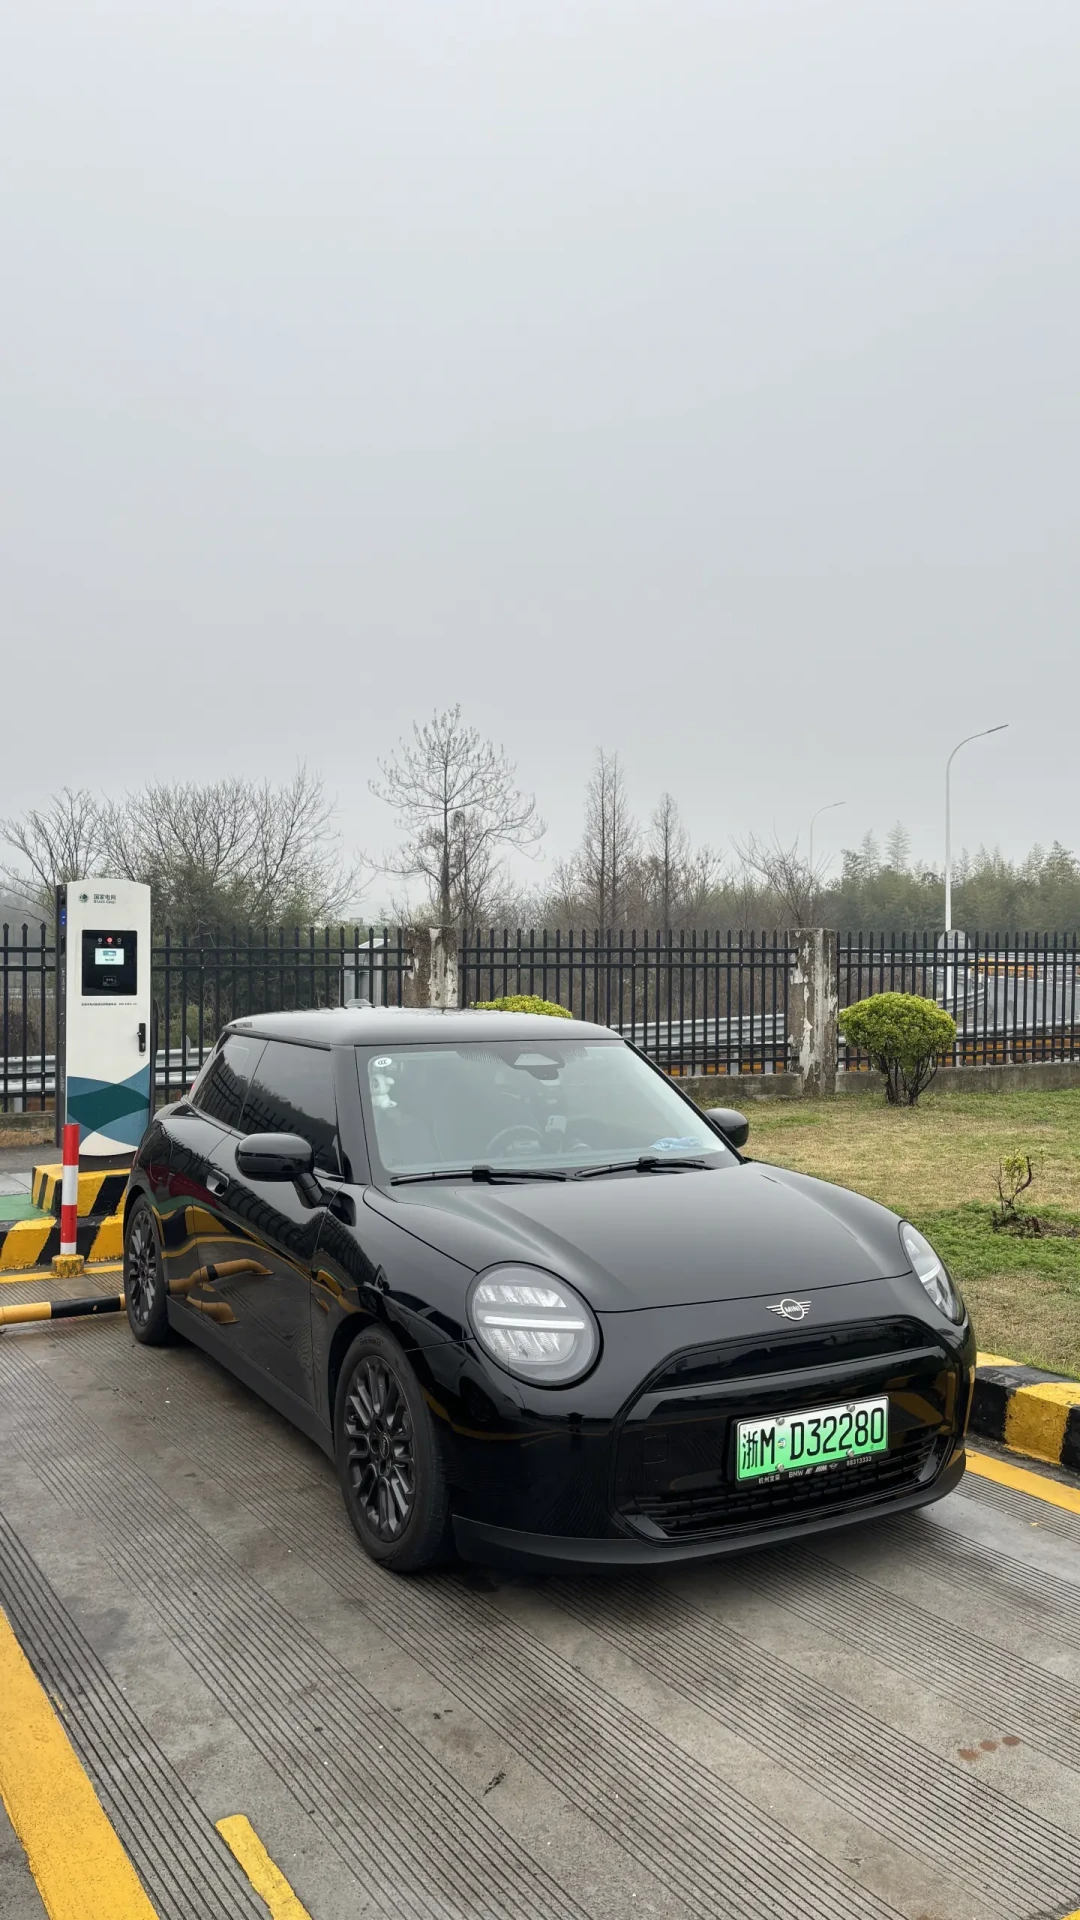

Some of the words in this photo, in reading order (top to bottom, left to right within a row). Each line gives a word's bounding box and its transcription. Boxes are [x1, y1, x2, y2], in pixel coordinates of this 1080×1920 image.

[742, 1427, 775, 1470] 浙M
[790, 1407, 885, 1461] D32280
[788, 1470, 804, 1478] BMW
